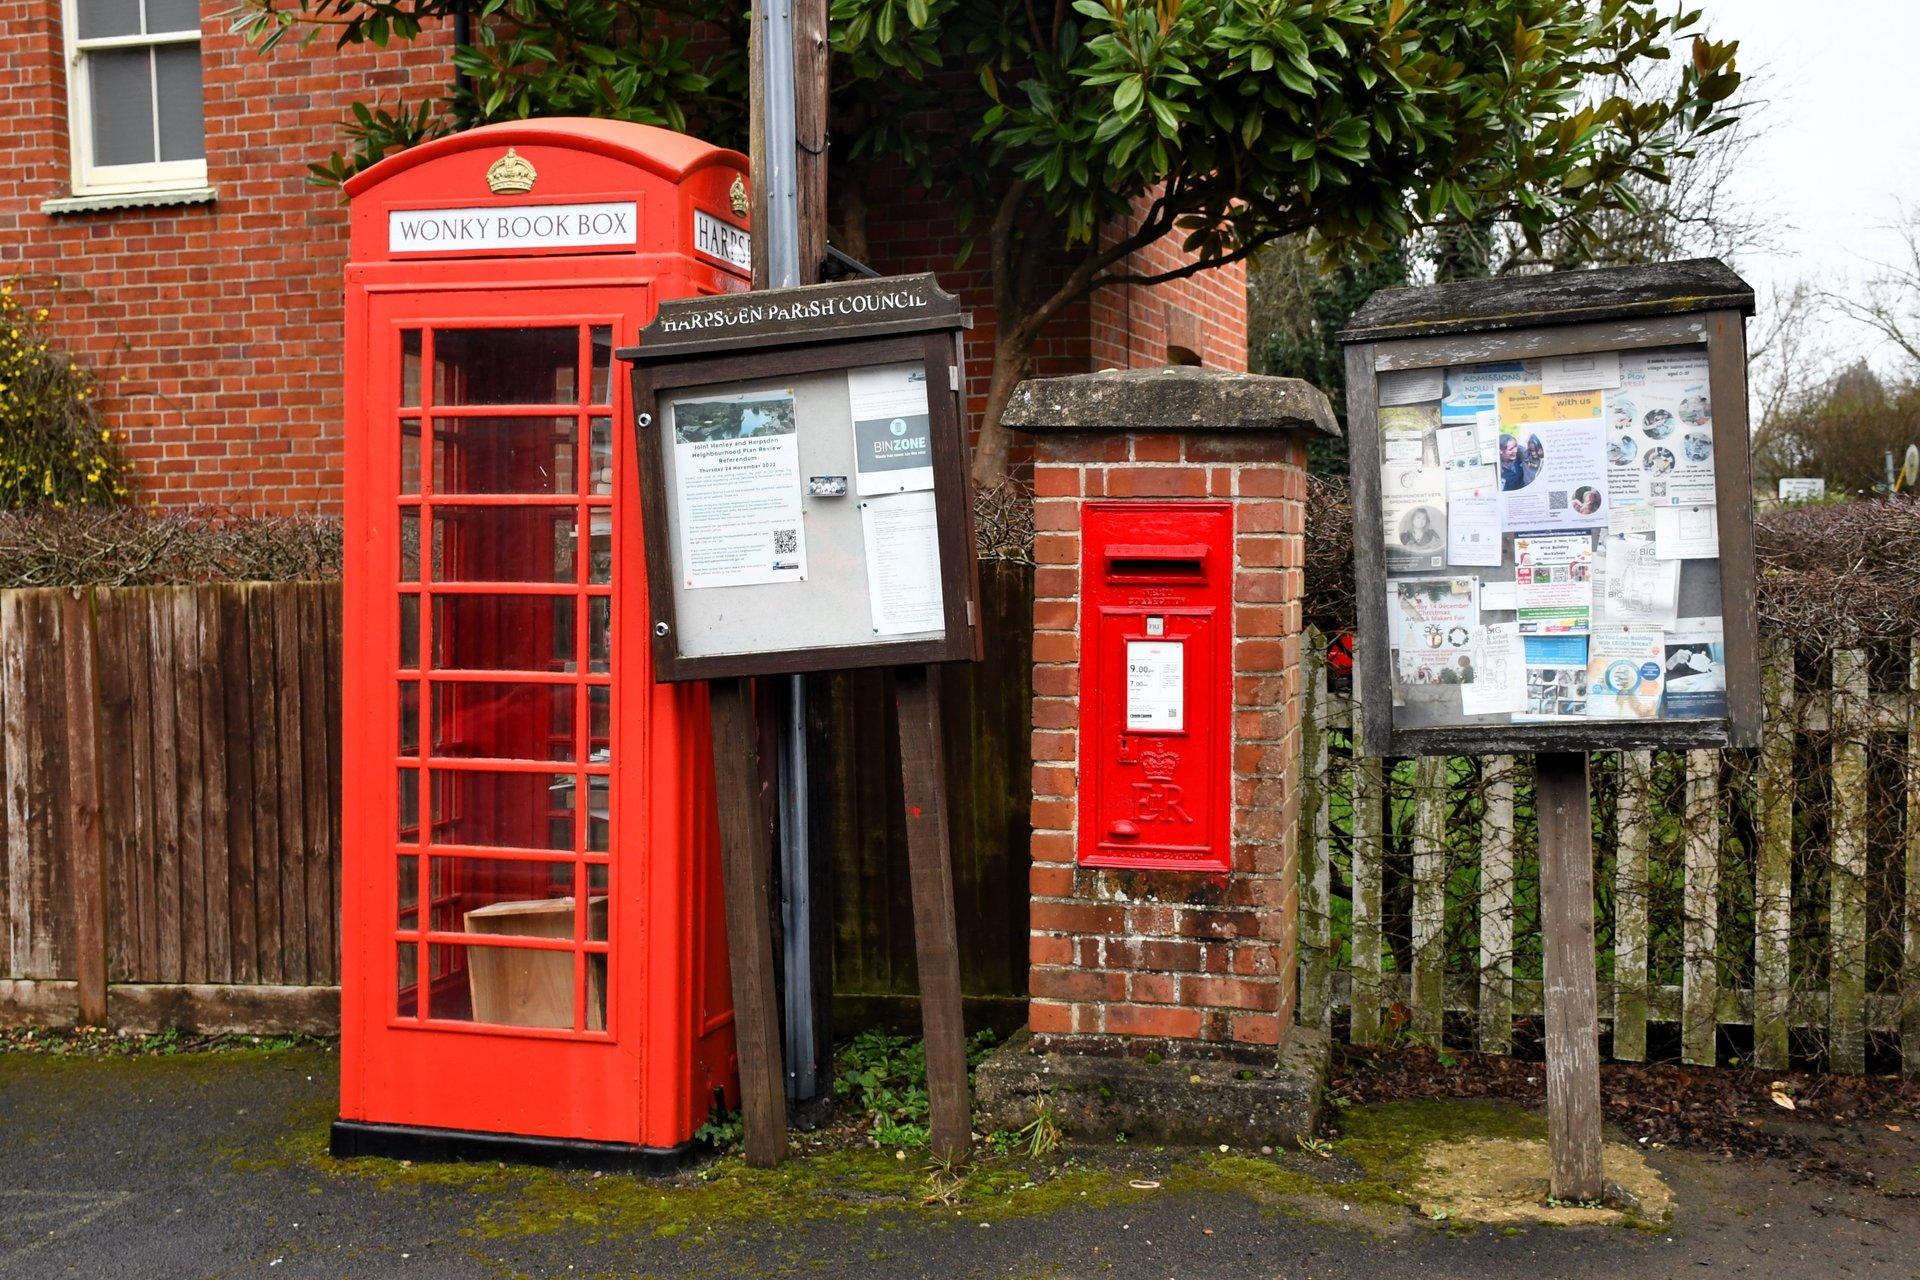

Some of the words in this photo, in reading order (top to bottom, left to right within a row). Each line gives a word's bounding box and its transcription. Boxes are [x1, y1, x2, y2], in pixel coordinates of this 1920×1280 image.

[400, 217, 490, 241] WONKY
[497, 214, 570, 239] BOOK
[578, 212, 628, 236] BOX
[699, 216, 752, 265] HARPS
[769, 300, 834, 321] PARISH
[839, 291, 927, 314] COUNCIL
[1464, 374, 1520, 382] ADMISSIONS
[1556, 398, 1577, 407] with
[710, 442, 733, 450] Henley
[748, 438, 779, 446] Harpsden
[874, 436, 926, 453] BINZONE
[692, 449, 742, 458] Neighbourhood
[718, 456, 757, 464] Referendum
